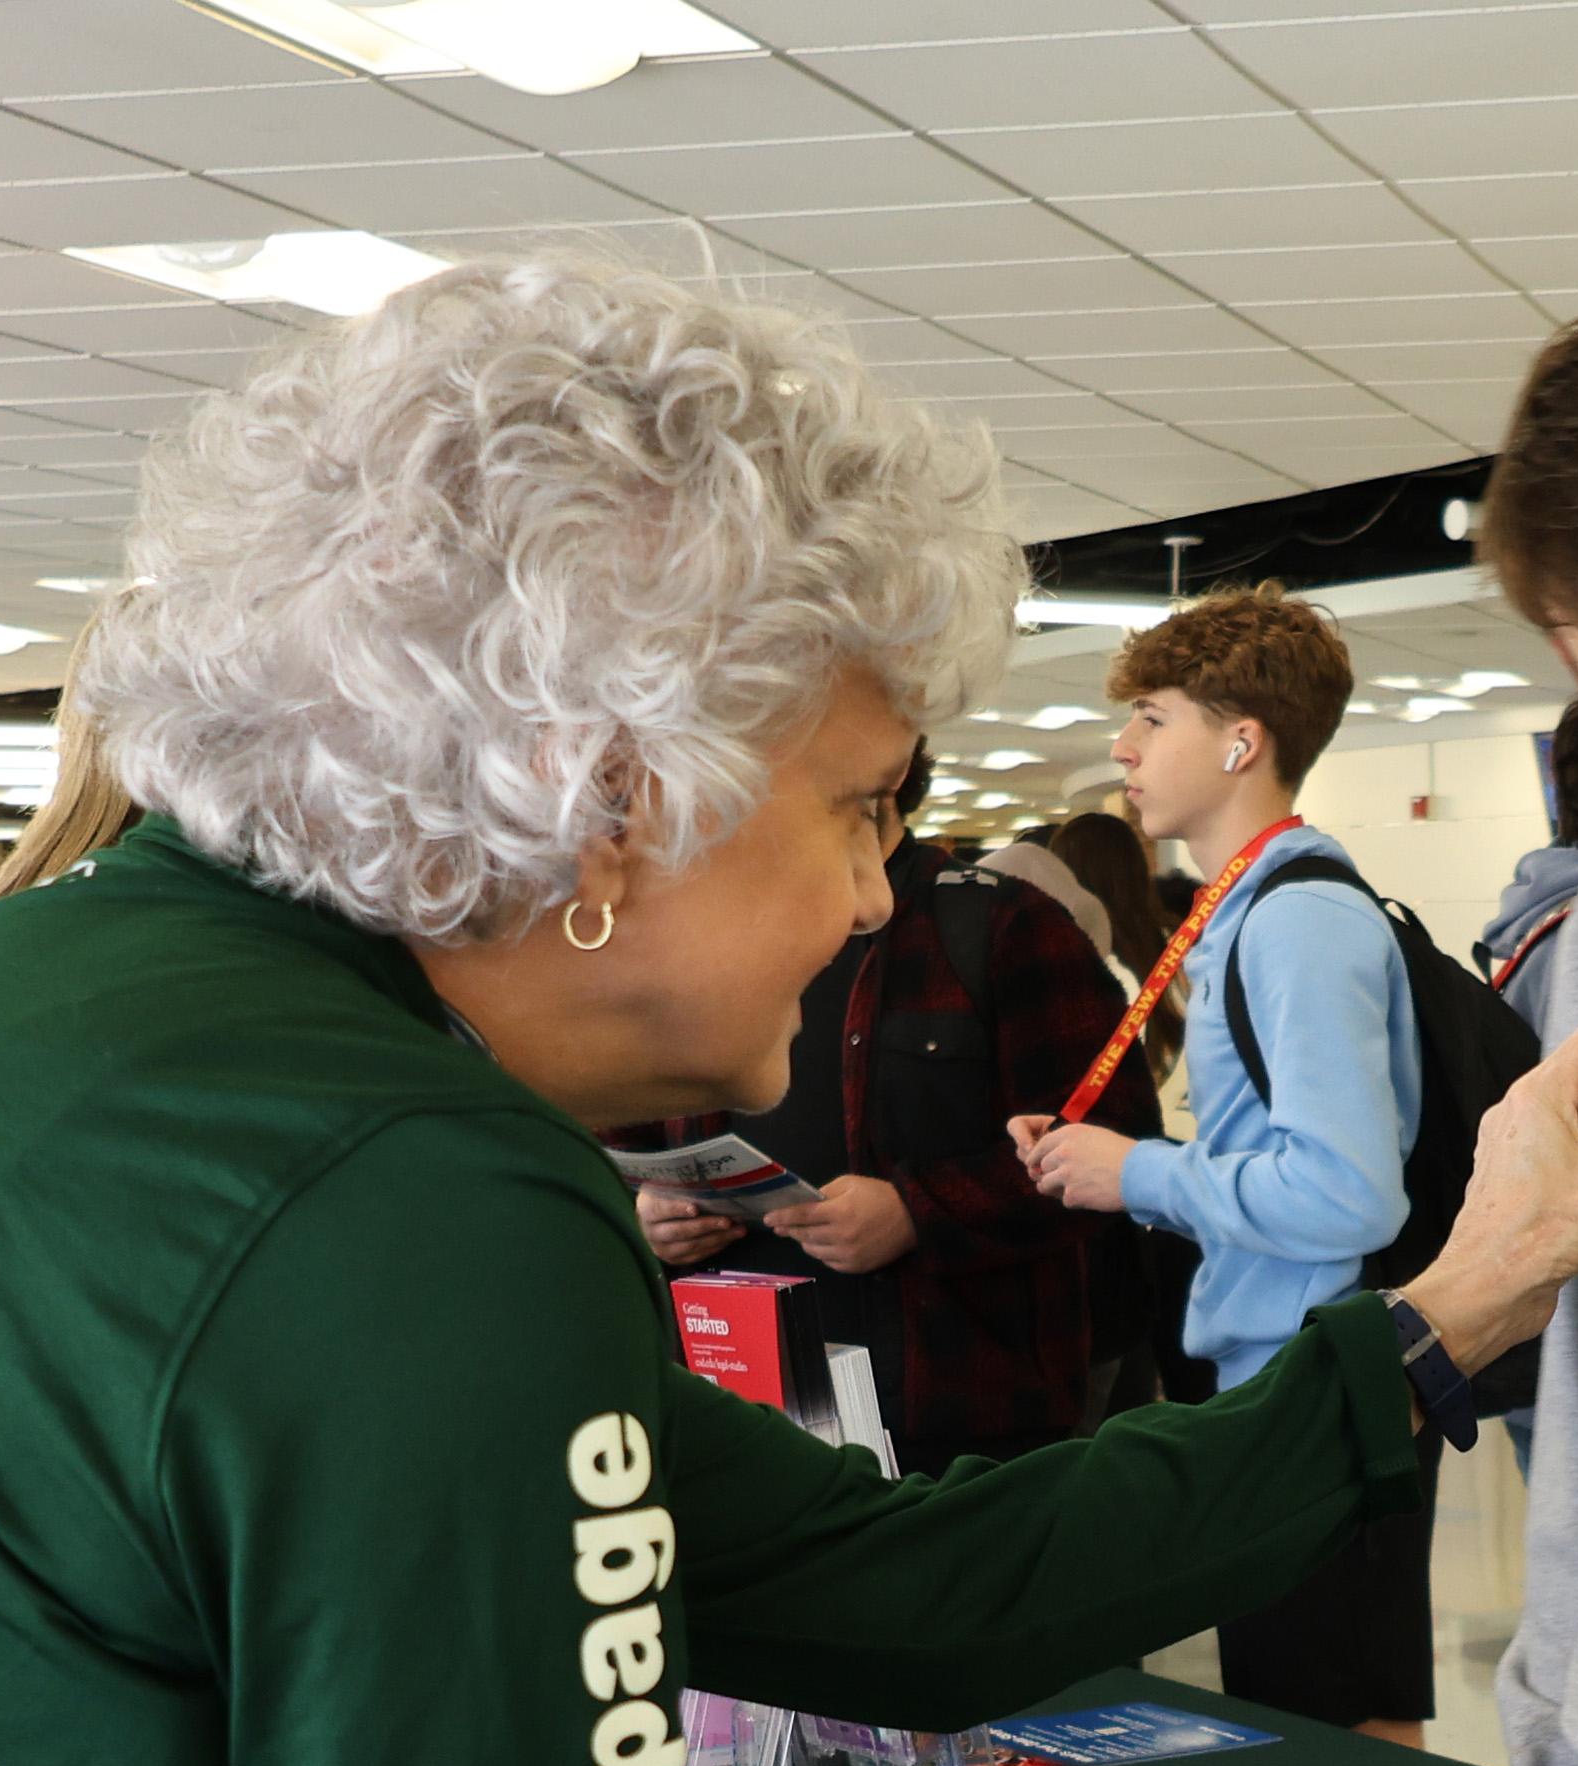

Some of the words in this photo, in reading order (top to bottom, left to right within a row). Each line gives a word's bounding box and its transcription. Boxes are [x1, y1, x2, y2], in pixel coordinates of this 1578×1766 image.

[1087, 1040, 1125, 1090] THE
[1117, 982, 1161, 1041] FEW.
[1153, 933, 1191, 981] THE
[1188, 858, 1250, 932] PROUD.
[682, 1302, 709, 1316] Getting
[685, 1318, 730, 1336] STARTED
